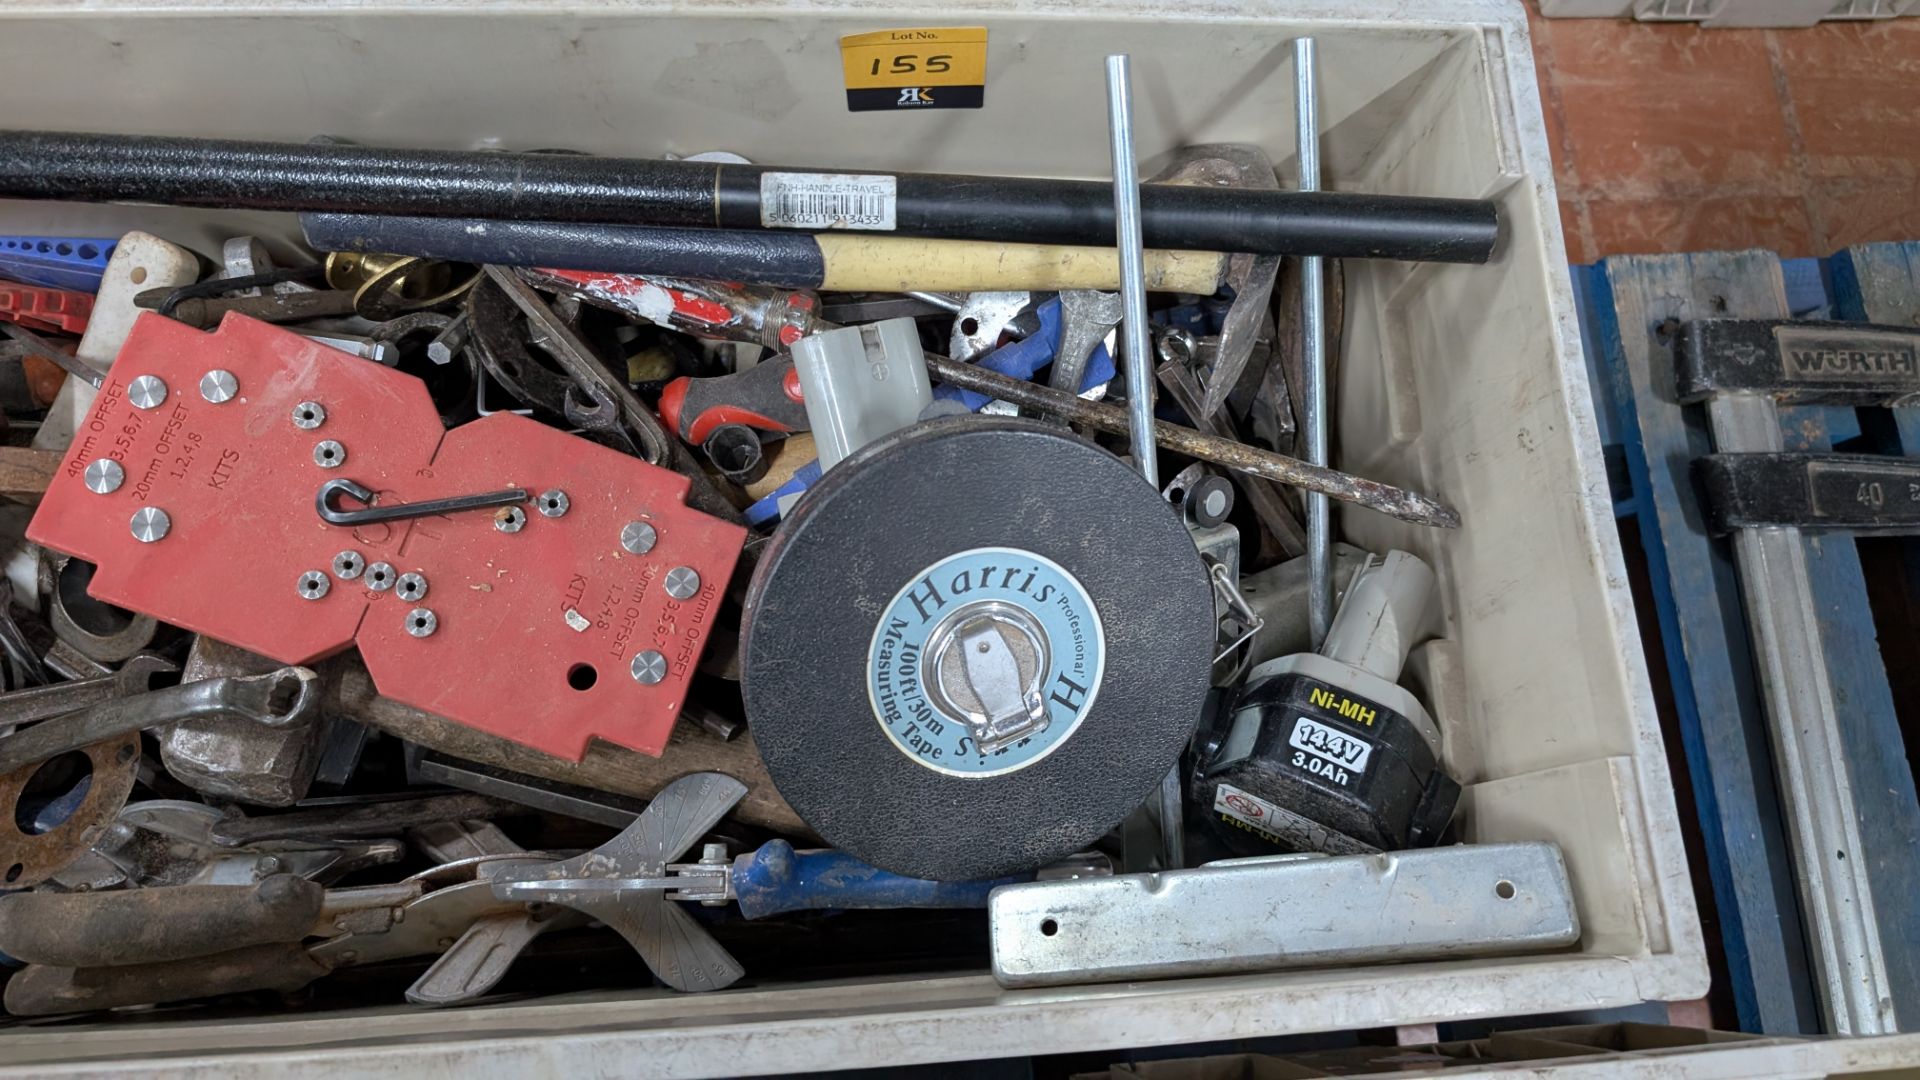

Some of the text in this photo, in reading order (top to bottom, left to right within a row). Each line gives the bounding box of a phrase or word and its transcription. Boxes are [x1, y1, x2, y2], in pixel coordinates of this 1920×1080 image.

[916, 32, 938, 40] No.
[871, 55, 953, 75] 155
[769, 213, 777, 222] 5
[1791, 351, 1912, 373] WÜRTH
[67, 378, 125, 478] 40mm OFFSET
[109, 411, 144, 462] 3,5,6,7
[132, 401, 190, 501] 20mm OFFSET
[170, 431, 203, 480] 1,2,4,8
[208, 448, 241, 490] KITS
[1856, 482, 1885, 506] 40
[596, 583, 624, 630] 1,2,4,8
[906, 565, 1057, 625] Harris
[609, 606, 641, 661] OFFSET
[652, 600, 681, 650] 3,5,6,7
[671, 583, 718, 681] 40mm OFFSET
[877, 616, 943, 760] Measuring Tape
[898, 641, 945, 737] 100ft/30m
[1310, 687, 1377, 727] Ni-MH
[1291, 751, 1349, 786] 3.0Ah
[1299, 724, 1364, 766] 14.4V
